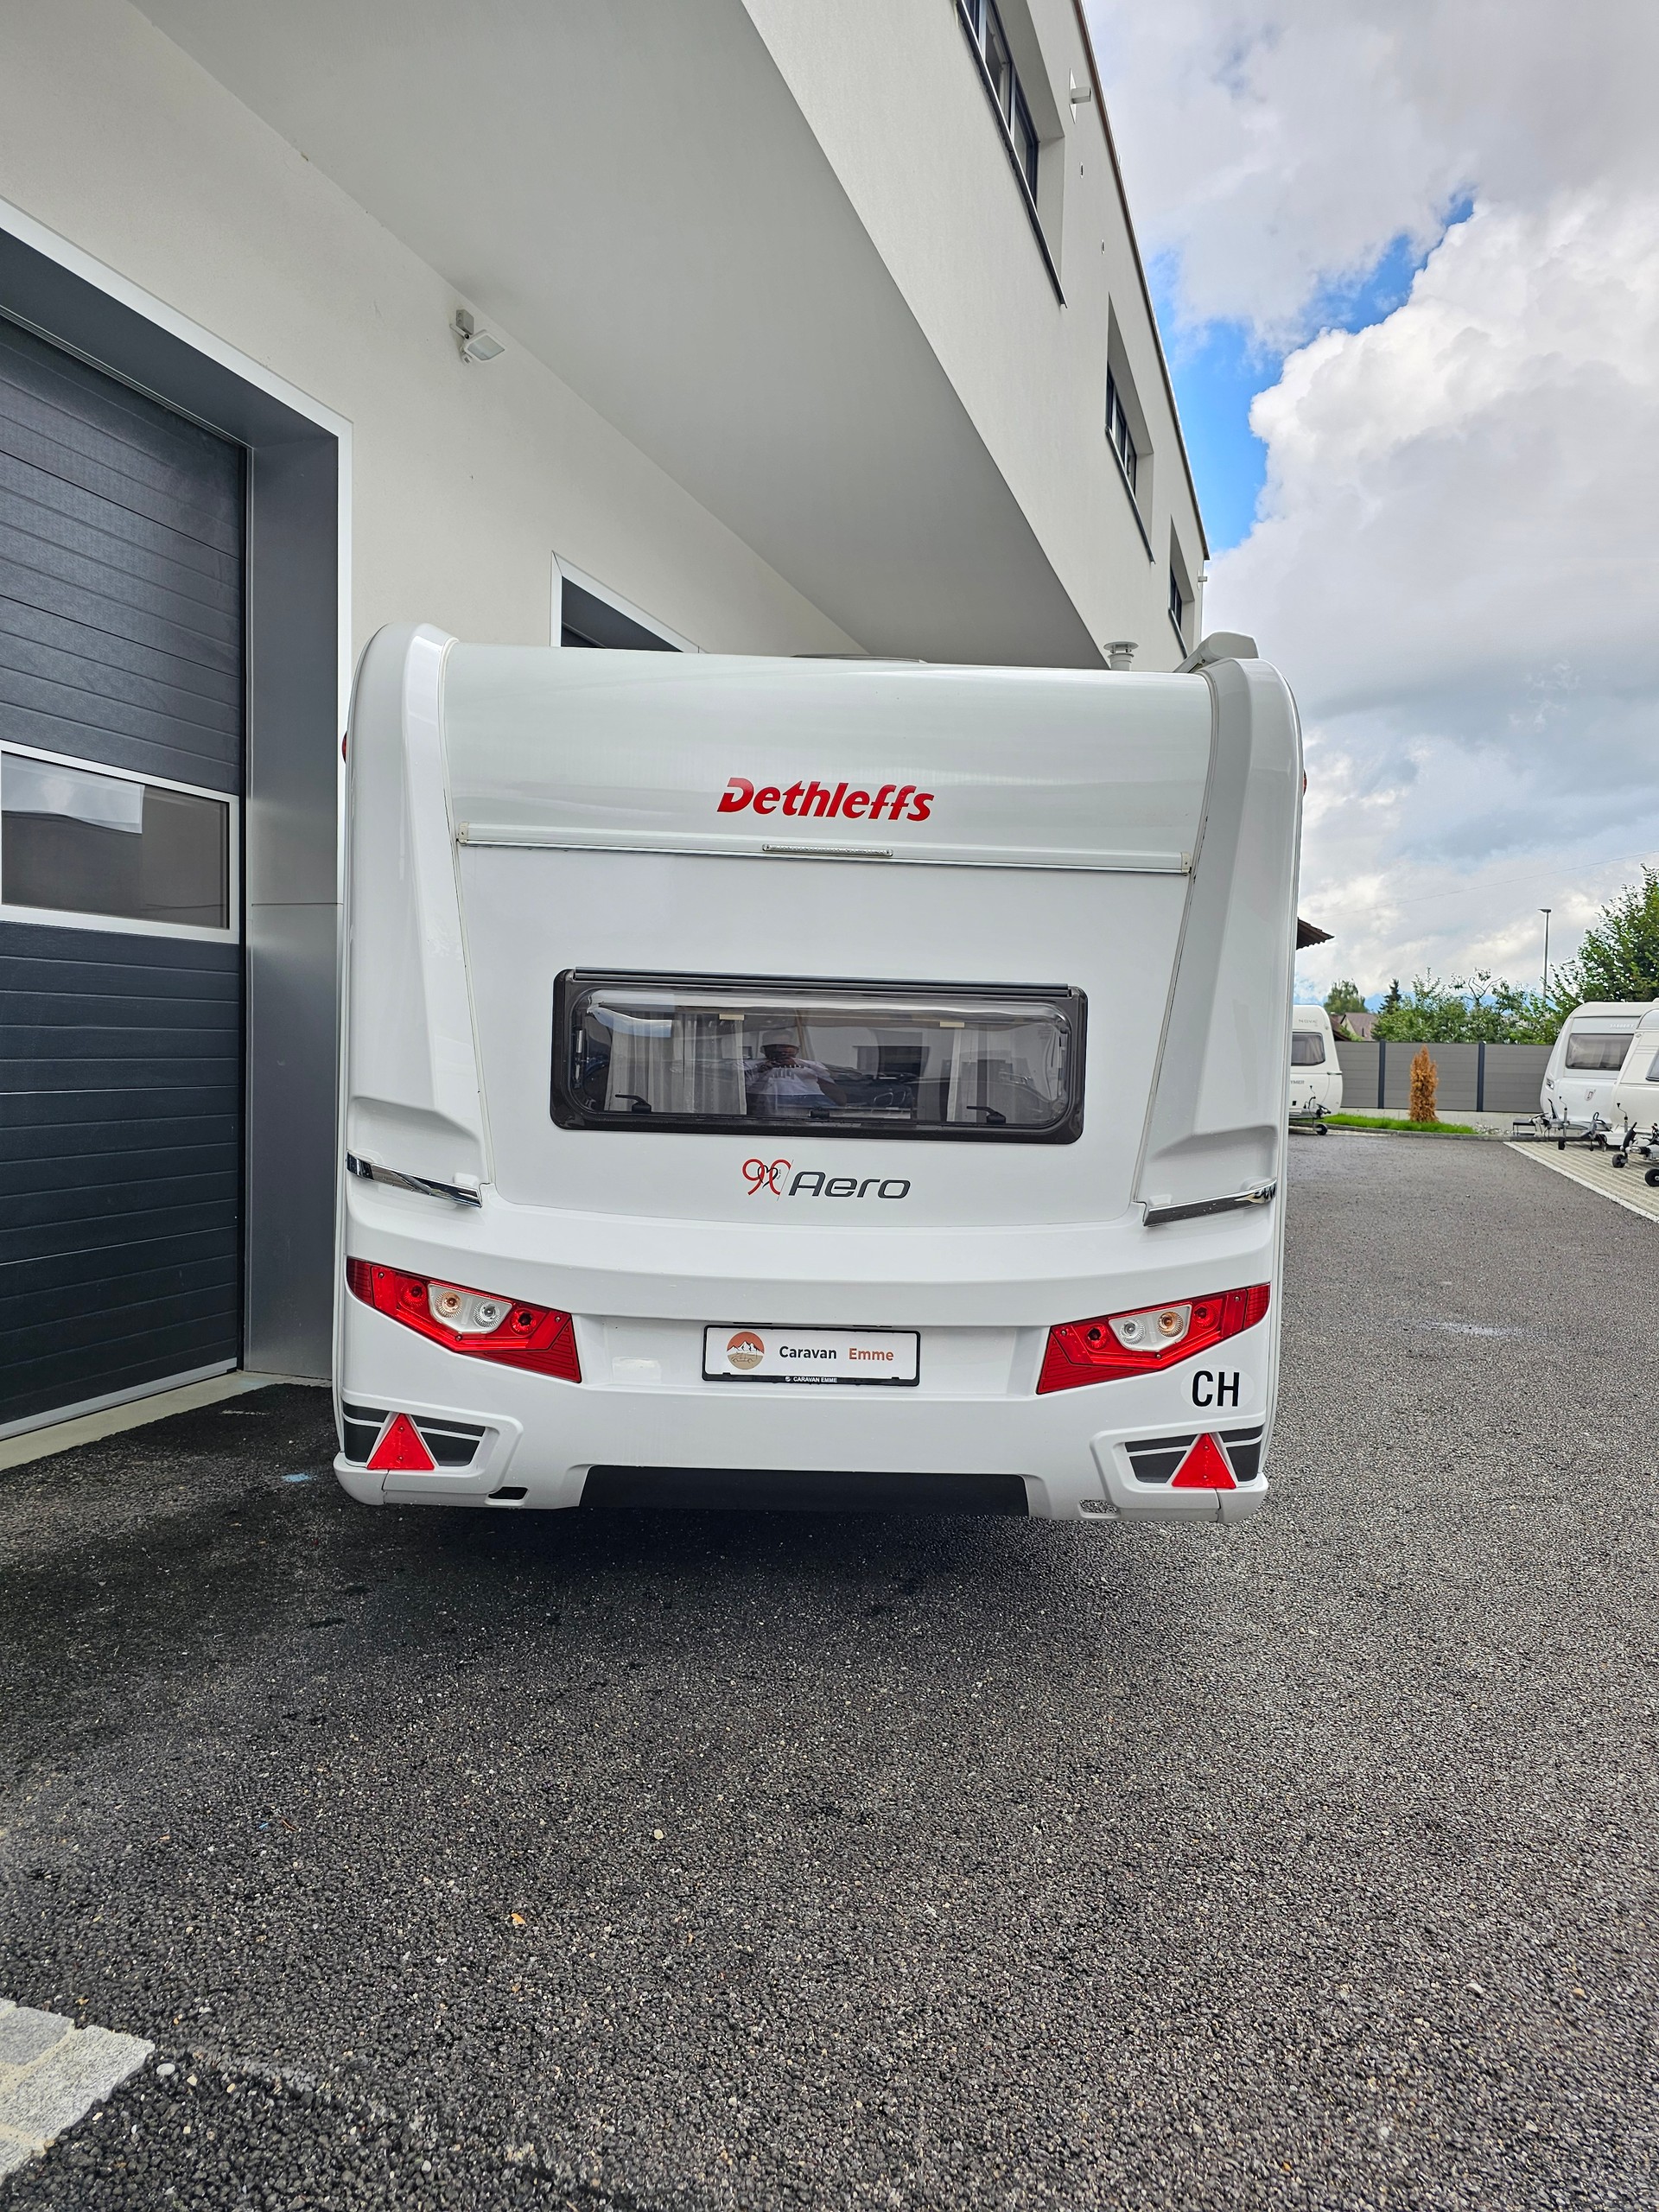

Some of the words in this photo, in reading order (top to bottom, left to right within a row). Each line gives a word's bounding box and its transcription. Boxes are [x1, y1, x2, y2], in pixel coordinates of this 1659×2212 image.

[716, 777, 935, 822] Dethleffs
[788, 1171, 912, 1199] Aero
[779, 1345, 837, 1360] Caravan
[848, 1347, 894, 1362] Emme
[1192, 1370, 1240, 1408] CH
